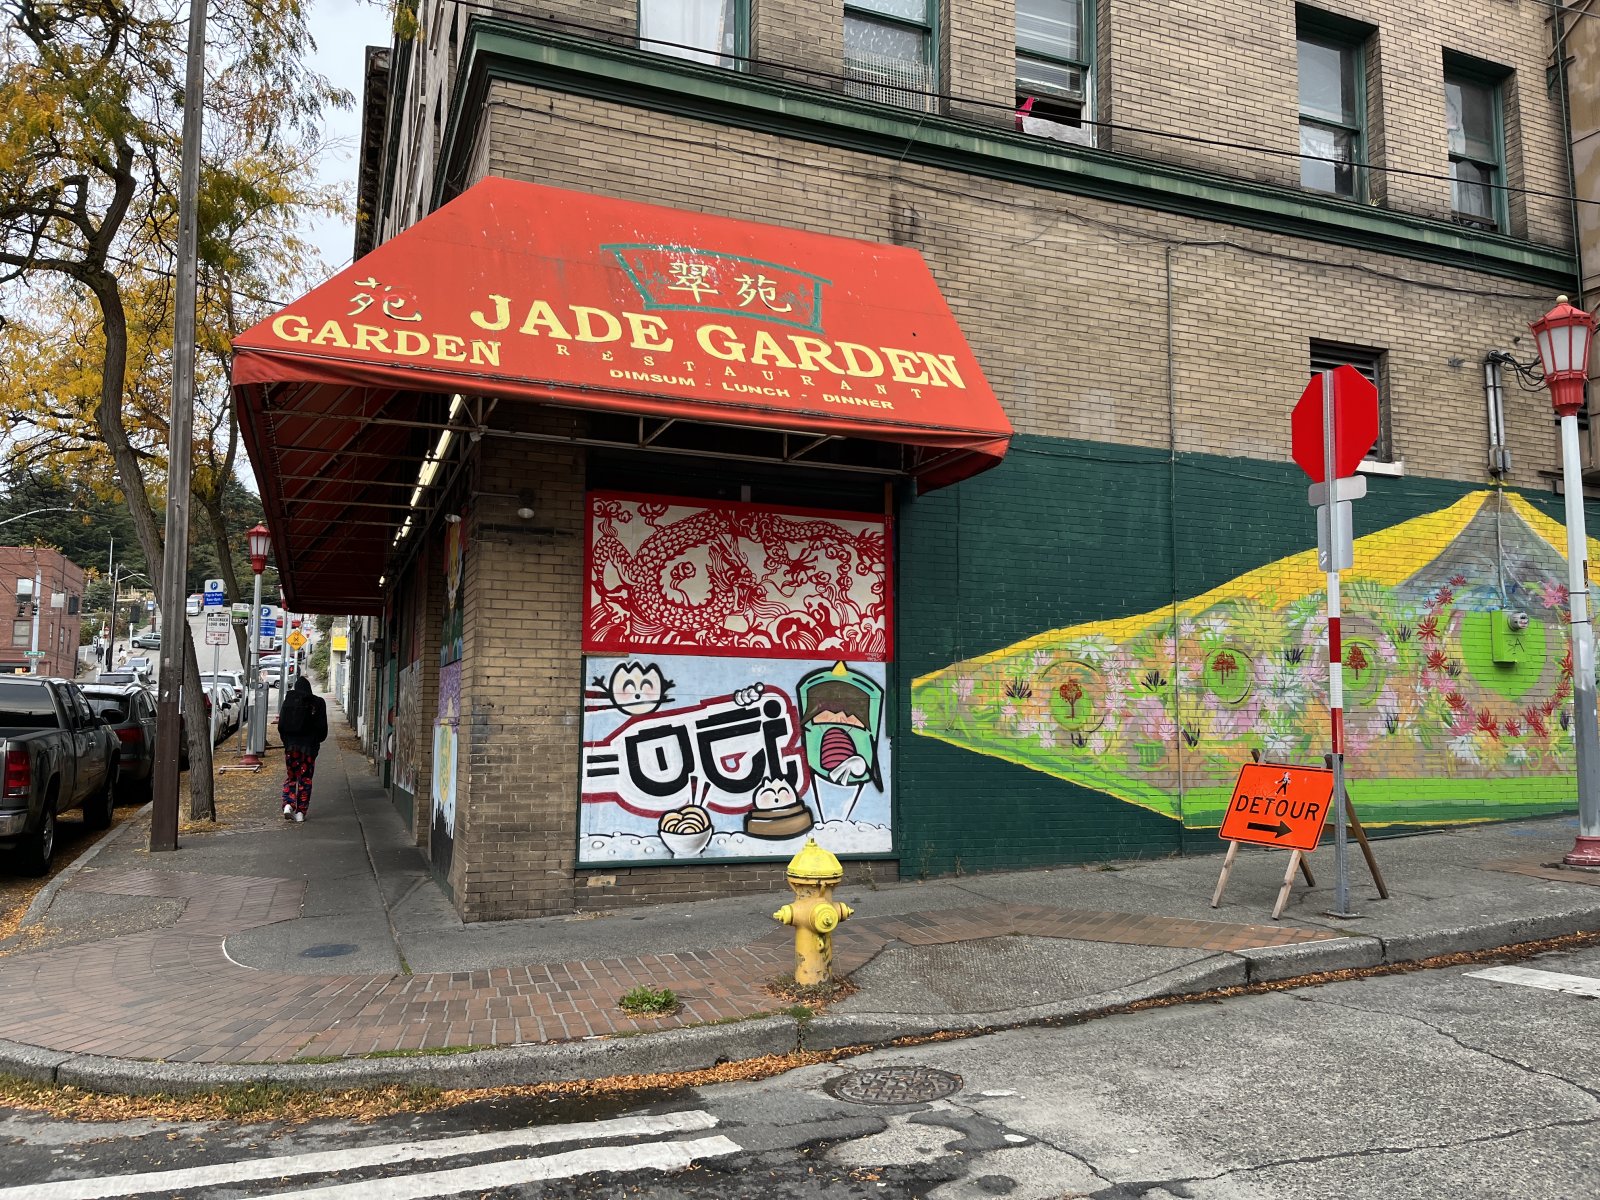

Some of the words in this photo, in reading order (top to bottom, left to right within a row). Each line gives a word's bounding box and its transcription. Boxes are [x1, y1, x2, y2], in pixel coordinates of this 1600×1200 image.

[667, 261, 793, 313] 翠苑
[271, 314, 502, 367] GARDEN
[469, 293, 674, 353] JADE
[695, 323, 966, 389] GARDEN
[555, 343, 922, 399] RESTAURANT
[609, 369, 696, 387] DIMSUM
[721, 381, 791, 398] LUNCH
[822, 393, 895, 410] DINNER
[1235, 795, 1320, 821] DETOUR
